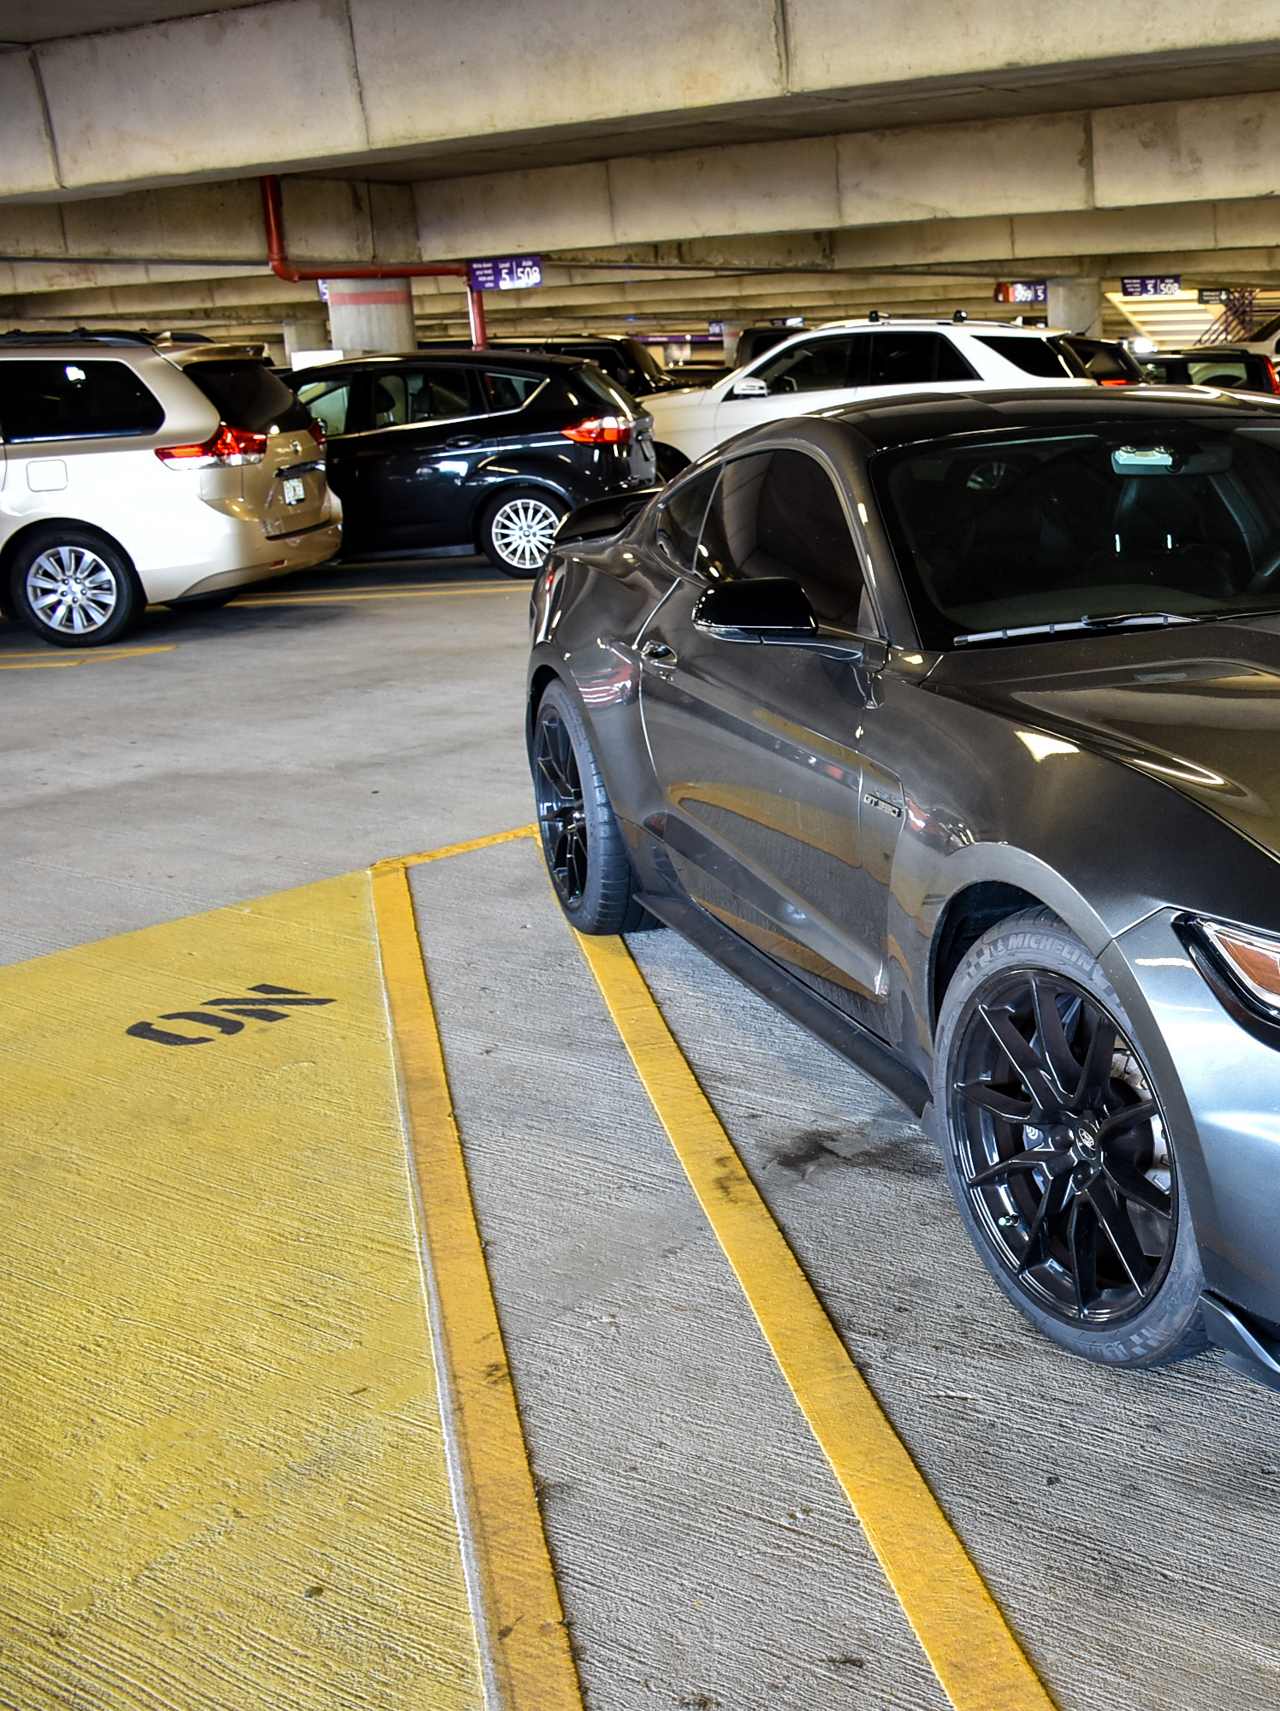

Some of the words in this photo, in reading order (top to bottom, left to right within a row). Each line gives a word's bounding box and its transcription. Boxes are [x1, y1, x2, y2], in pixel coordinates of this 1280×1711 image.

[517, 266, 541, 284] 508
[1037, 289, 1045, 301] 5
[1147, 284, 1155, 295] 5
[1159, 283, 1180, 295] 508
[1007, 932, 1095, 973] MICHELIN
